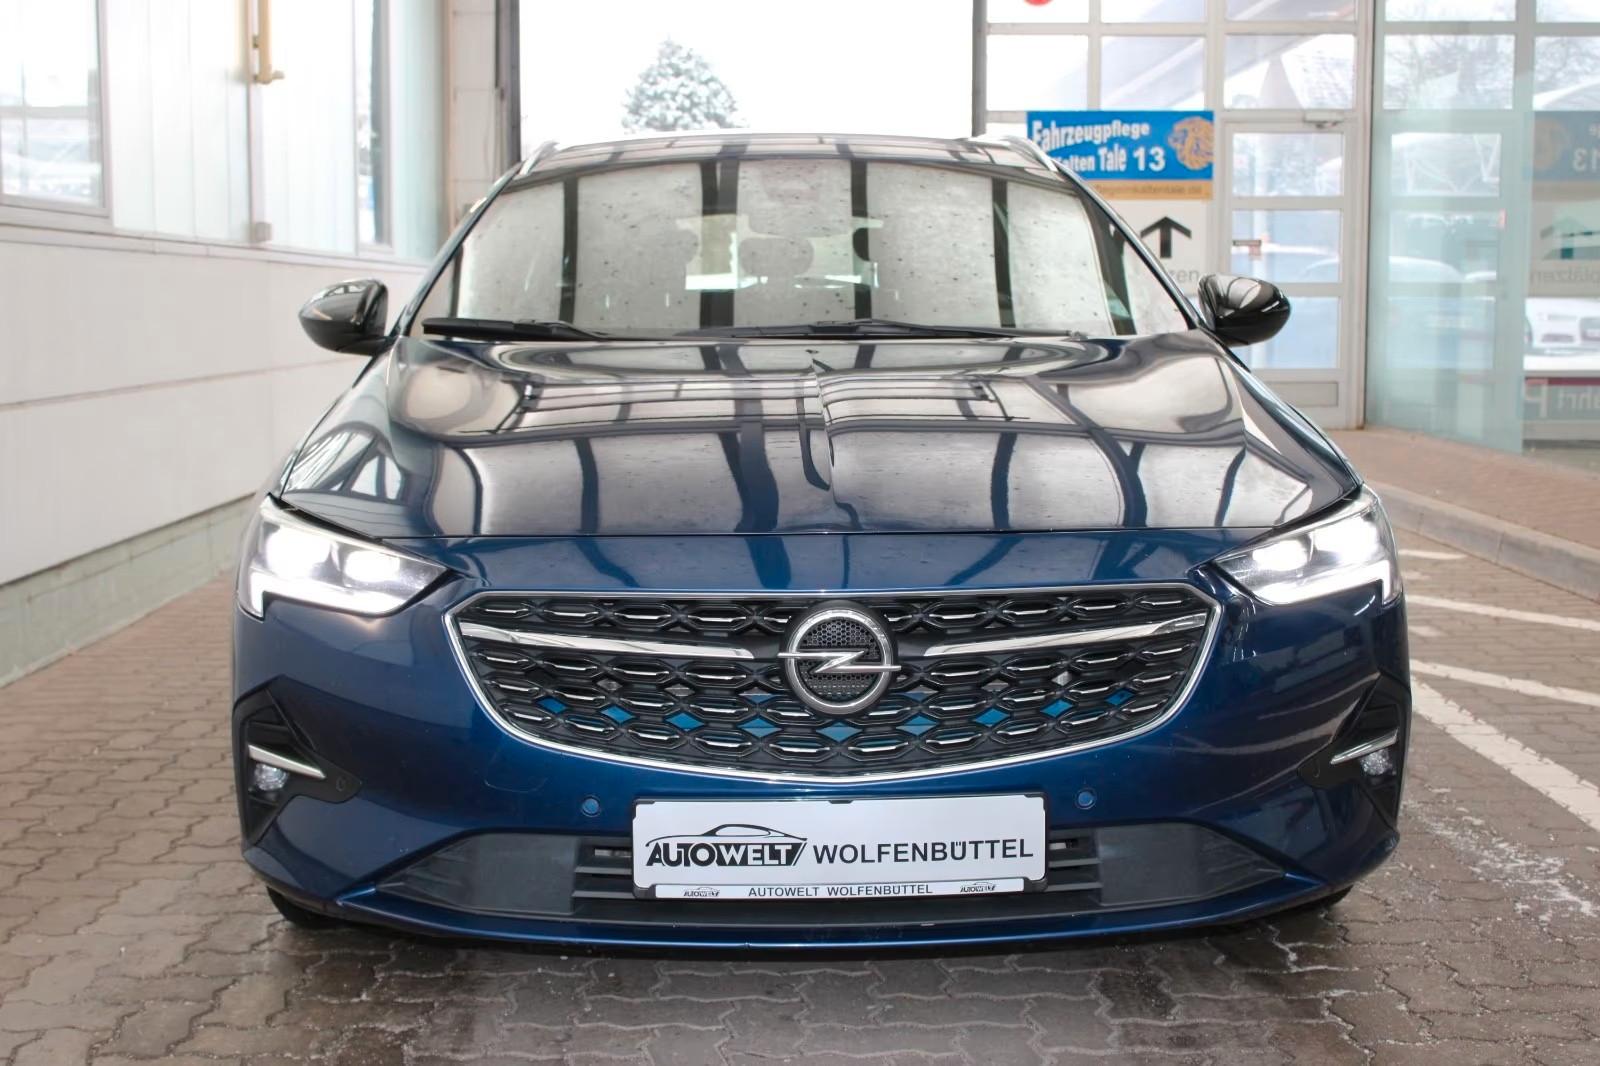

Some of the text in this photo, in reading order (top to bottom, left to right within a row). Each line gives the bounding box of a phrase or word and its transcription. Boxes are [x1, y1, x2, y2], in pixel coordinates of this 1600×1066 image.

[1032, 119, 1150, 151] Fahrzeugpflege
[1098, 143, 1127, 172] Tale
[1133, 146, 1166, 172] 13
[646, 838, 1034, 867] AUTOWELT WOLFENBÜTTEL
[748, 886, 820, 897] AUTOWELT
